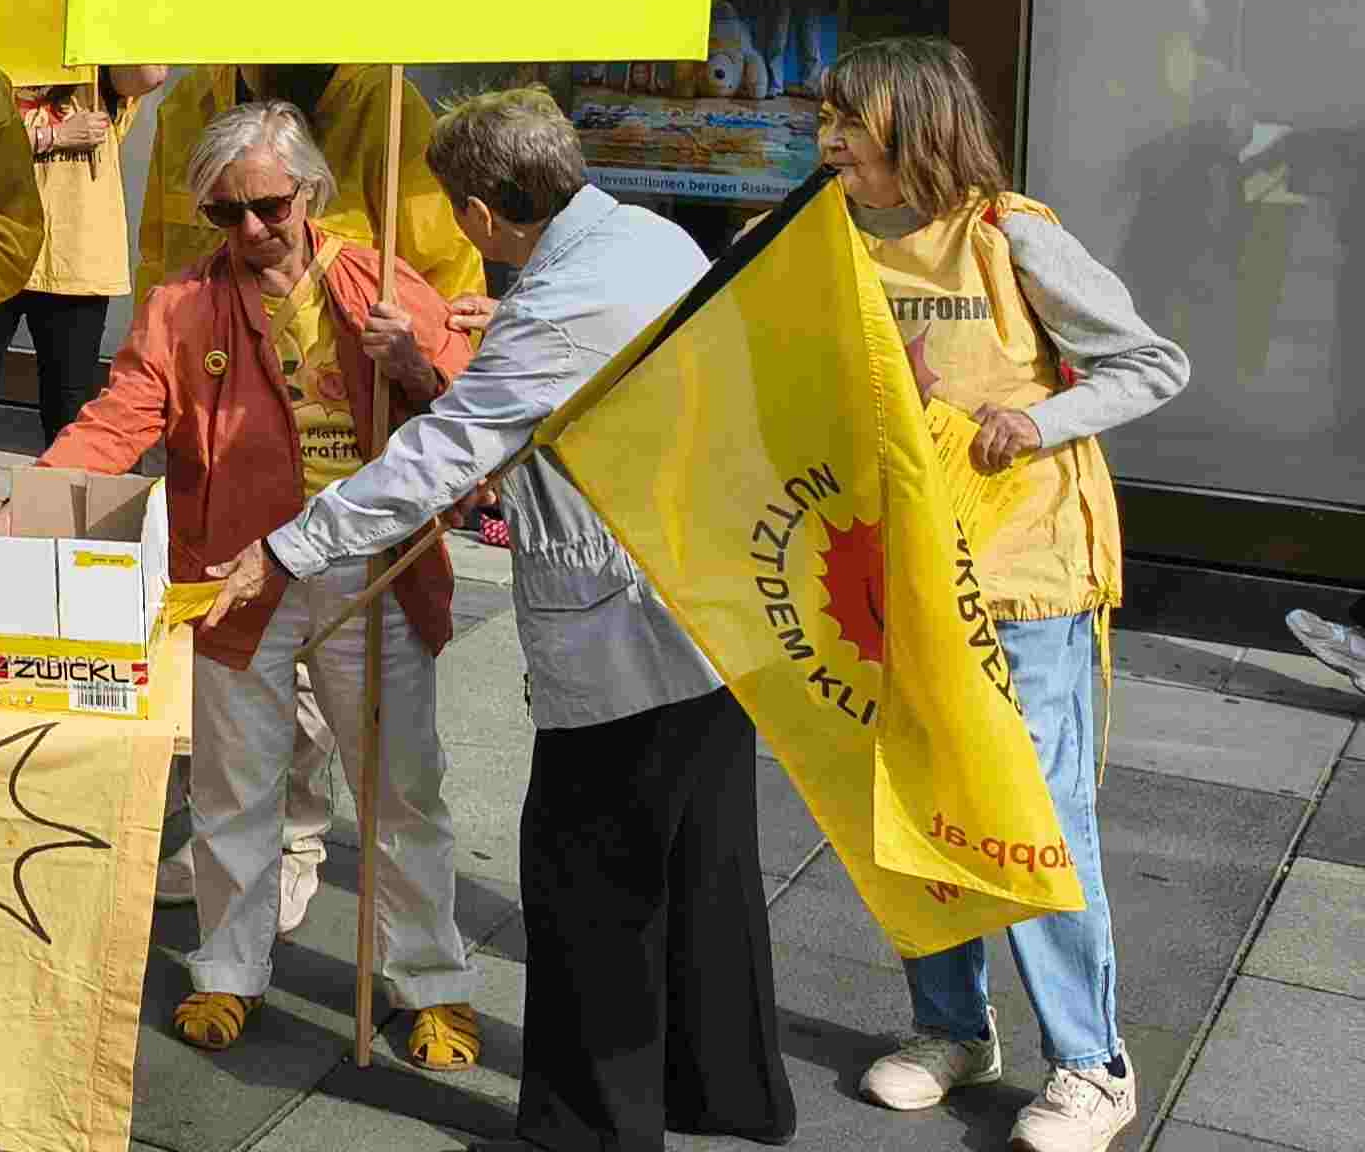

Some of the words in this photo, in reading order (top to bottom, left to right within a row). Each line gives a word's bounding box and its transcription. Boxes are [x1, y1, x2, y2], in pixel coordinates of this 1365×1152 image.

[750, 462, 841, 573] NUTZT
[755, 575, 815, 660] DEM
[13, 660, 129, 684] ZWICKL
[807, 665, 876, 725] KLI
